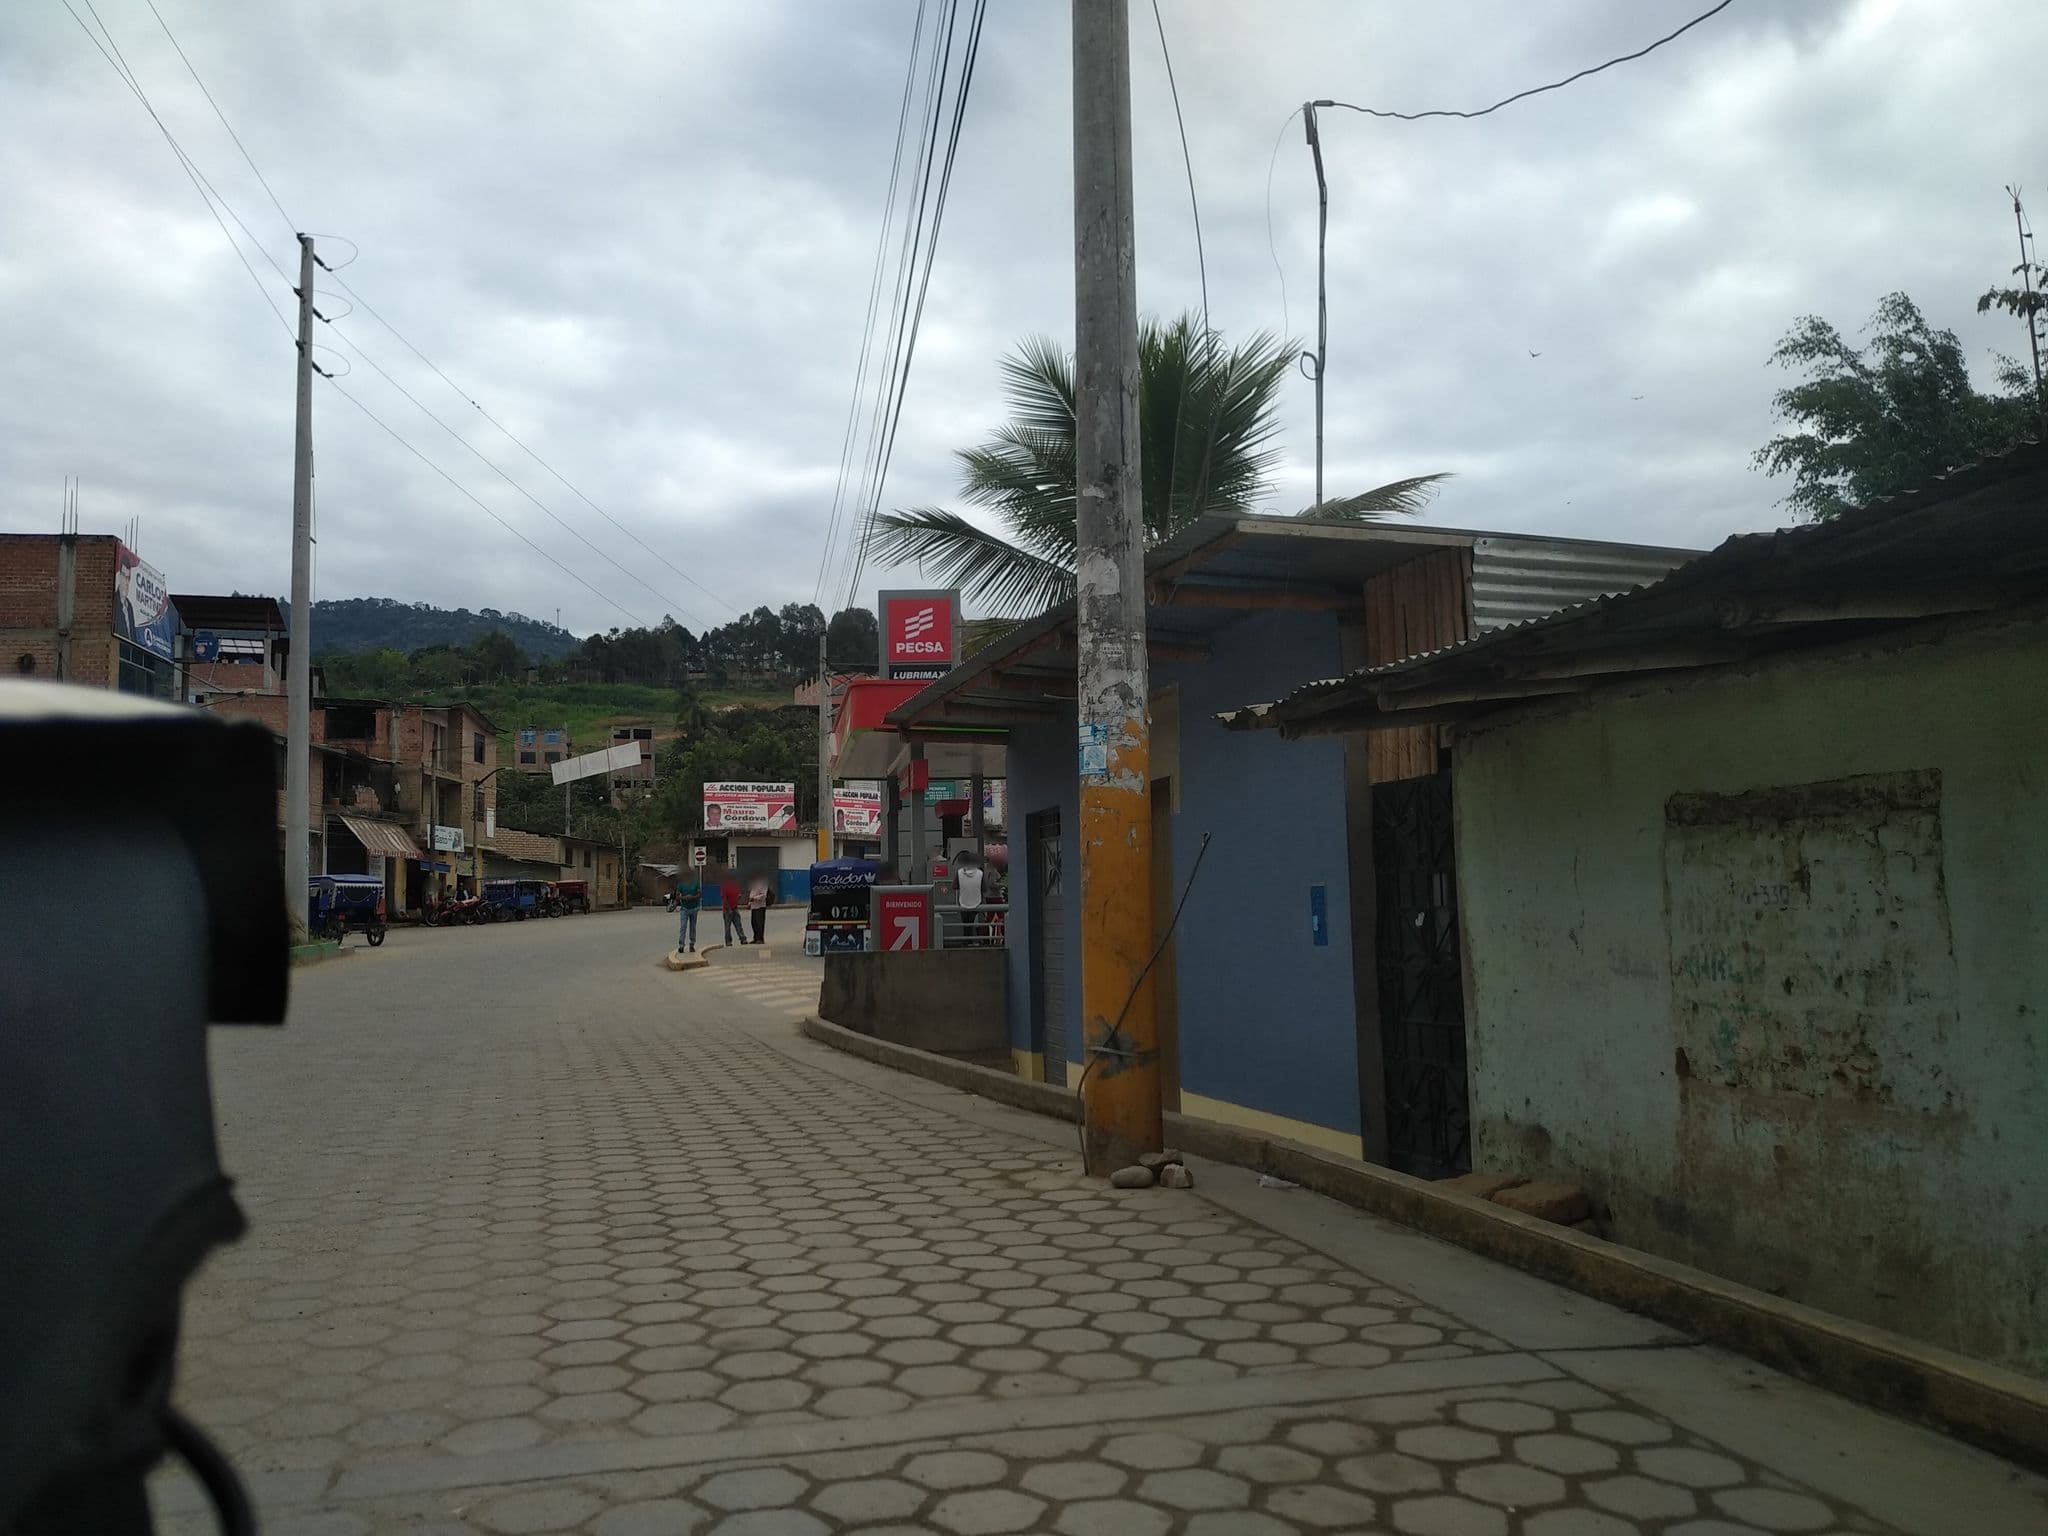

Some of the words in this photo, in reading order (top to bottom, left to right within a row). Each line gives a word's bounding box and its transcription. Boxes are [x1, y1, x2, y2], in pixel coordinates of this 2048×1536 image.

[896, 641, 944, 653] PECSA
[893, 671, 945, 680] LUBRIMAX
[751, 784, 786, 793] POPULAR
[859, 792, 879, 801] POPULAR
[885, 900, 922, 909] BIENVENIDO
[831, 905, 860, 919] 079
